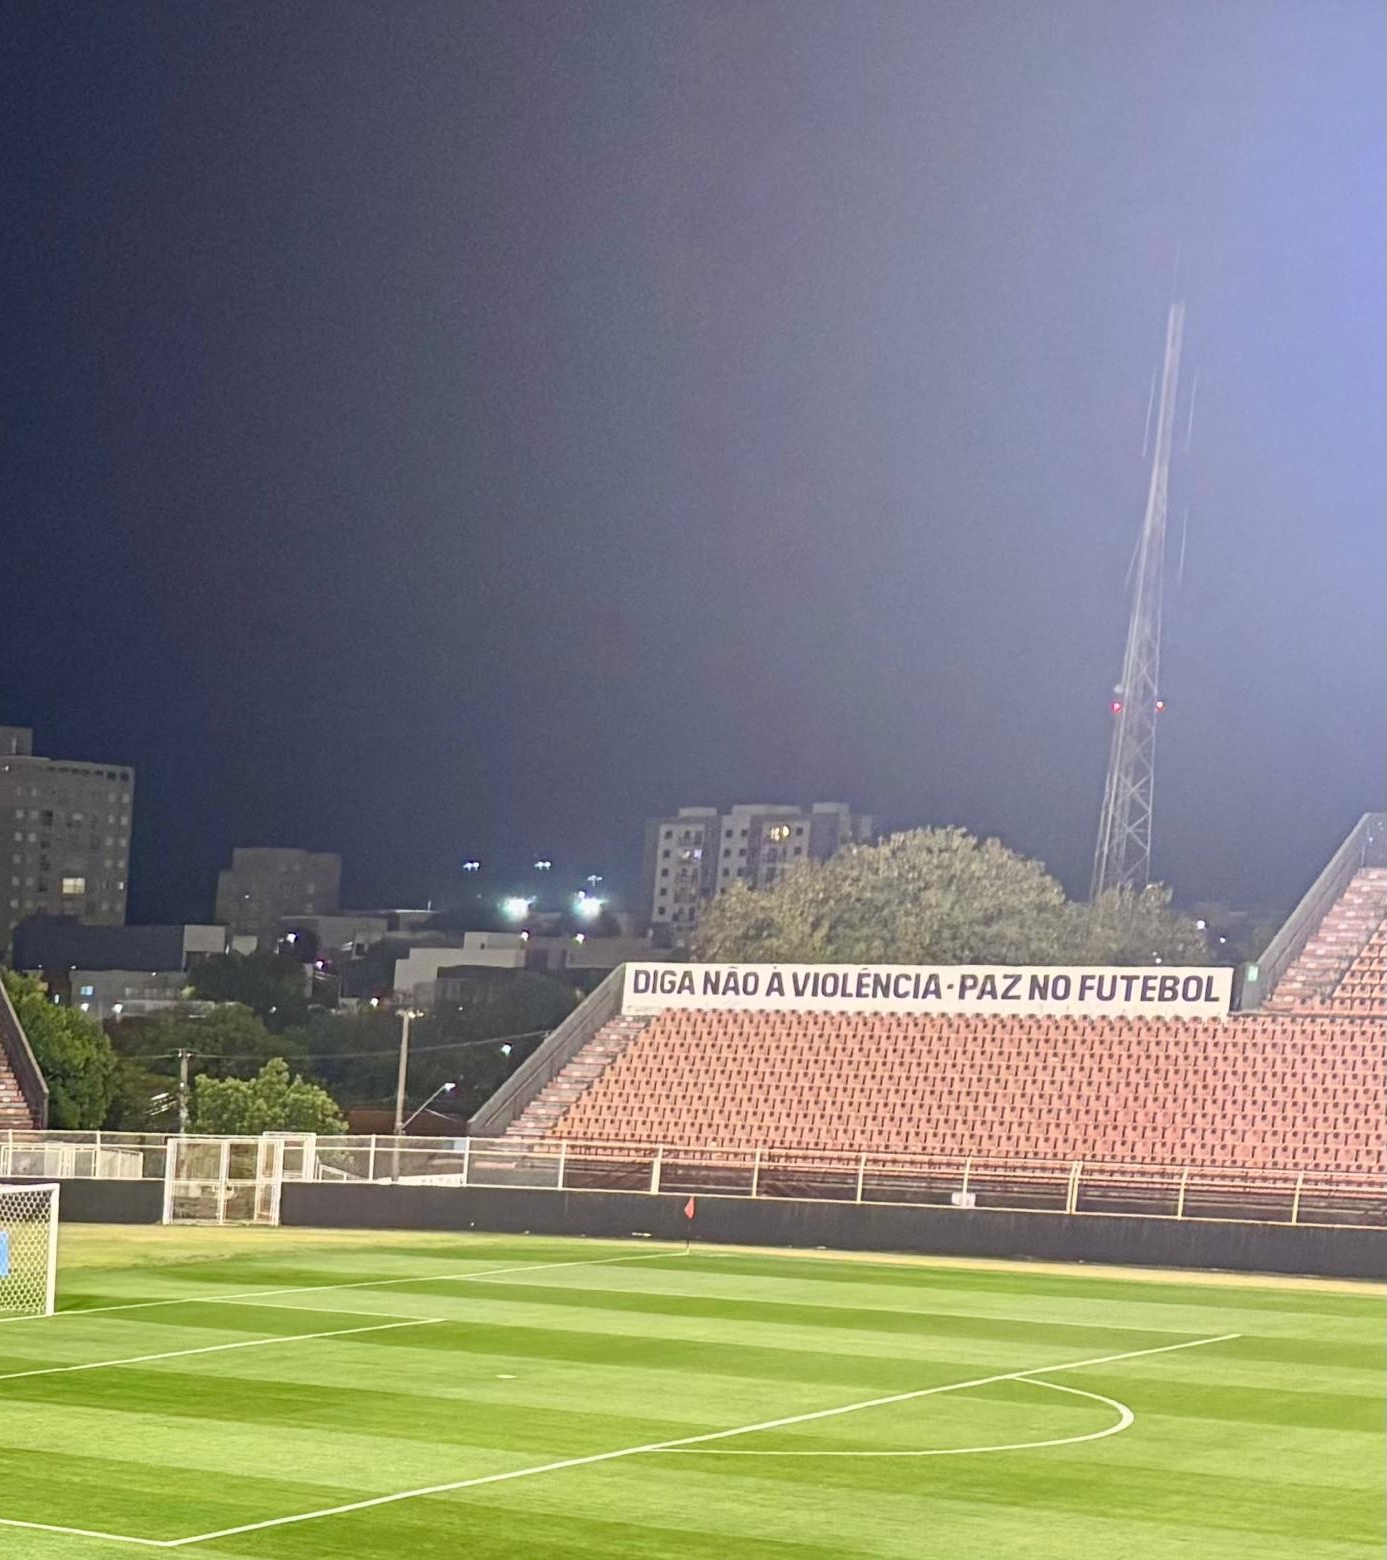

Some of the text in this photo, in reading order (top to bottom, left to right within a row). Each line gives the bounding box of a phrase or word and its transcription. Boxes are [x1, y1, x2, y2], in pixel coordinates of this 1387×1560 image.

[633, 969, 695, 995] DIGA
[703, 966, 759, 996] NÃO
[792, 967, 942, 1000] VIOLÊNCIA
[958, 973, 1022, 1000] PAZ
[1028, 974, 1071, 1001] NO
[1078, 974, 1219, 1003] FUTEBOL
